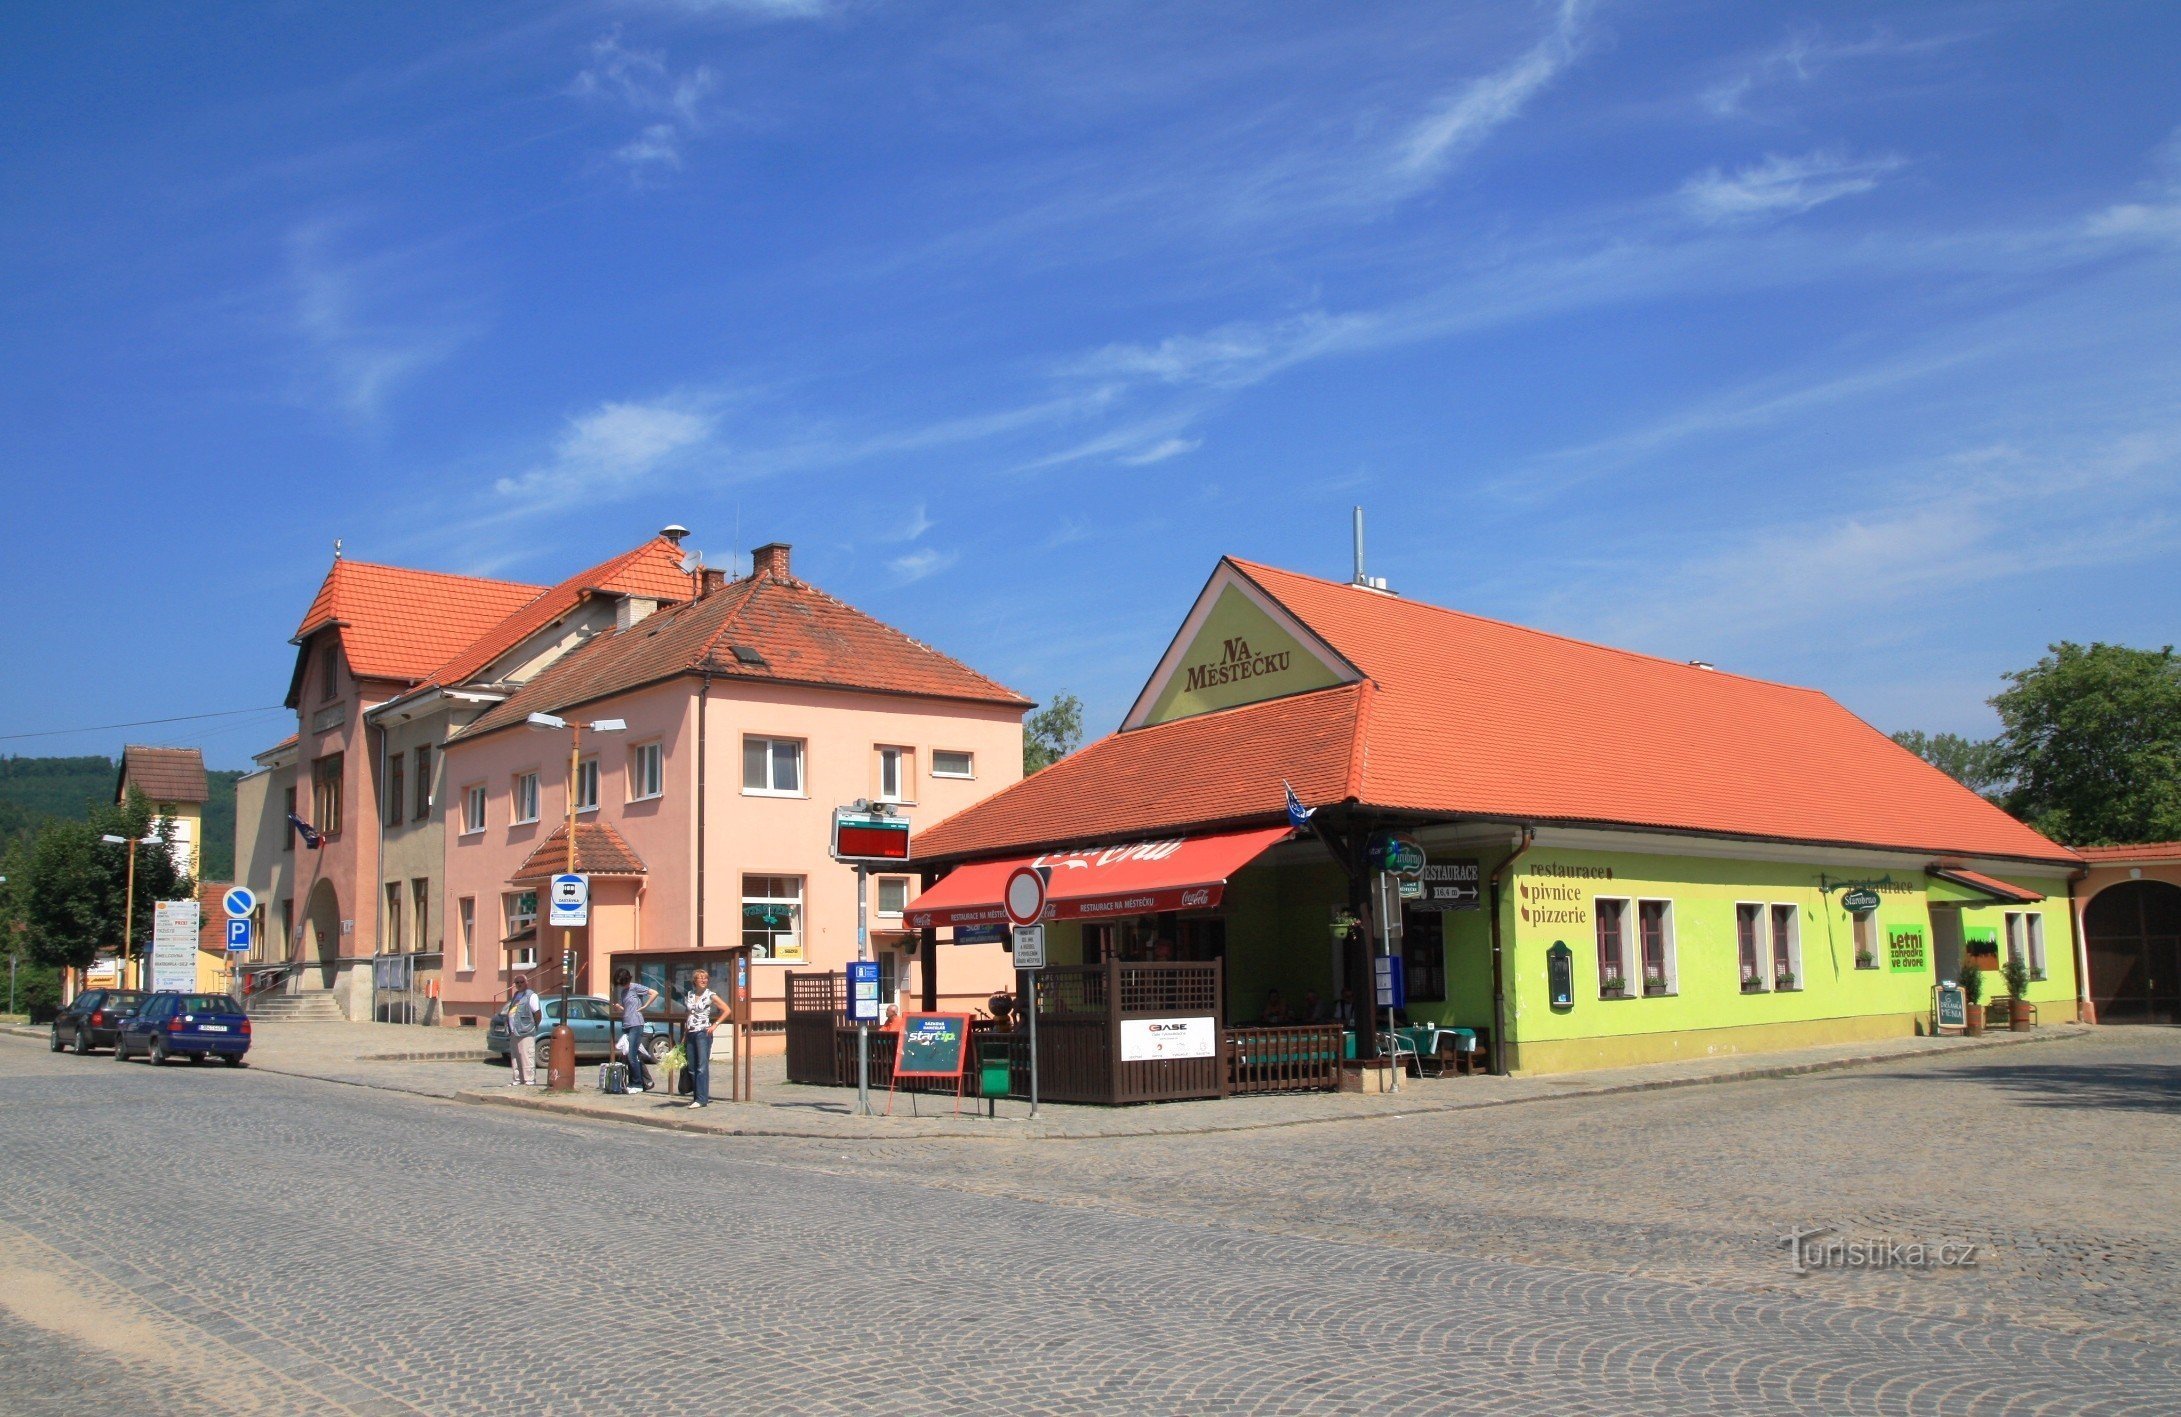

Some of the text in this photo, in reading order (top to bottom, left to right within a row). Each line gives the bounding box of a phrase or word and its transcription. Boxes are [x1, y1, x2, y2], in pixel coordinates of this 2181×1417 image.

[1530, 862, 1605, 880] restaurace
[1436, 888, 1459, 897] 16,4 m
[1531, 882, 1581, 904] pivnice
[1844, 892, 1877, 906] Starobrno
[1080, 902, 1114, 912] RESTAURACE
[1114, 900, 1123, 909] NA
[951, 911, 979, 921] RESTAURACE
[979, 911, 987, 920] NA
[1533, 906, 1587, 928] pizzerie
[231, 922, 247, 941] P
[1891, 959, 1901, 968] ve
